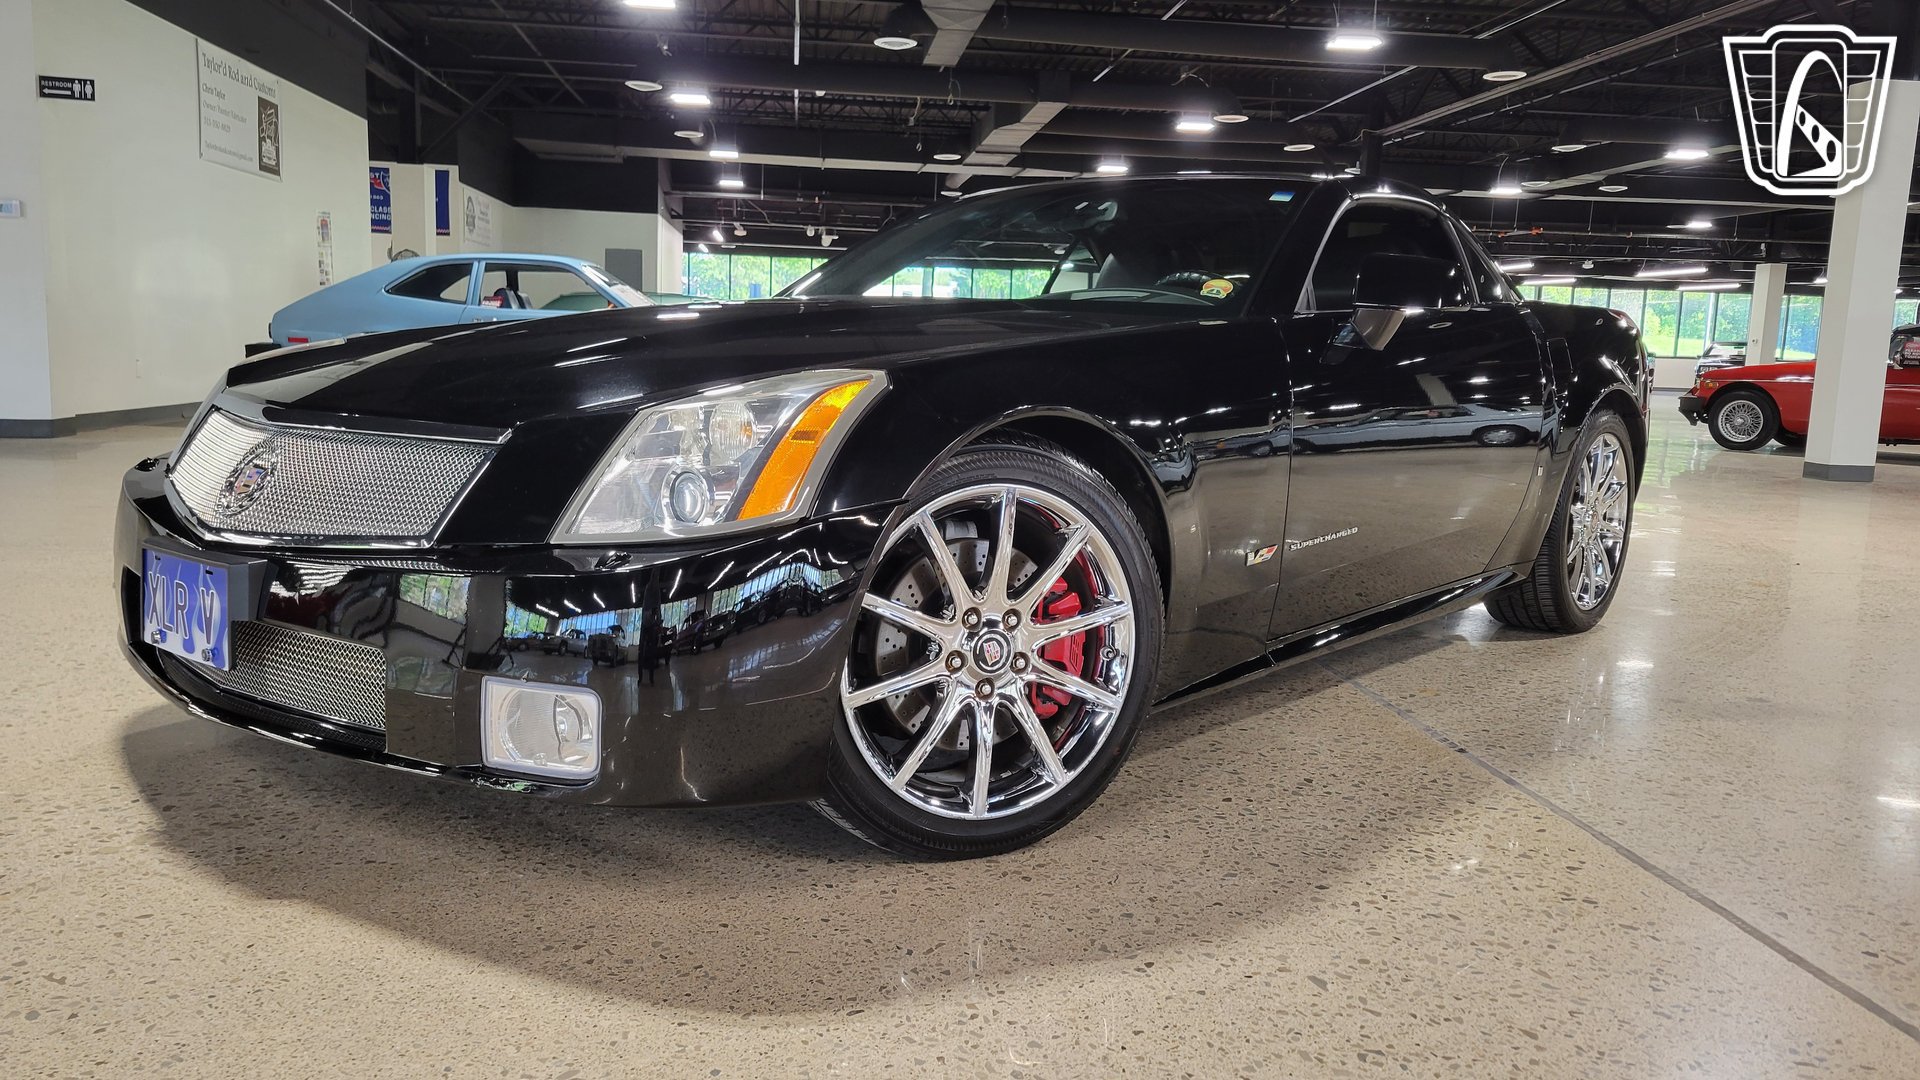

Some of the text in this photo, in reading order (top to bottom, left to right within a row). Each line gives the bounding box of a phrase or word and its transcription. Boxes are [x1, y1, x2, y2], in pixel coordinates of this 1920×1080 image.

[41, 80, 72, 88] RESTROOM
[240, 74, 253, 88] and
[1289, 526, 1359, 552] SUPERCHARGED
[148, 571, 215, 647] XLR V
